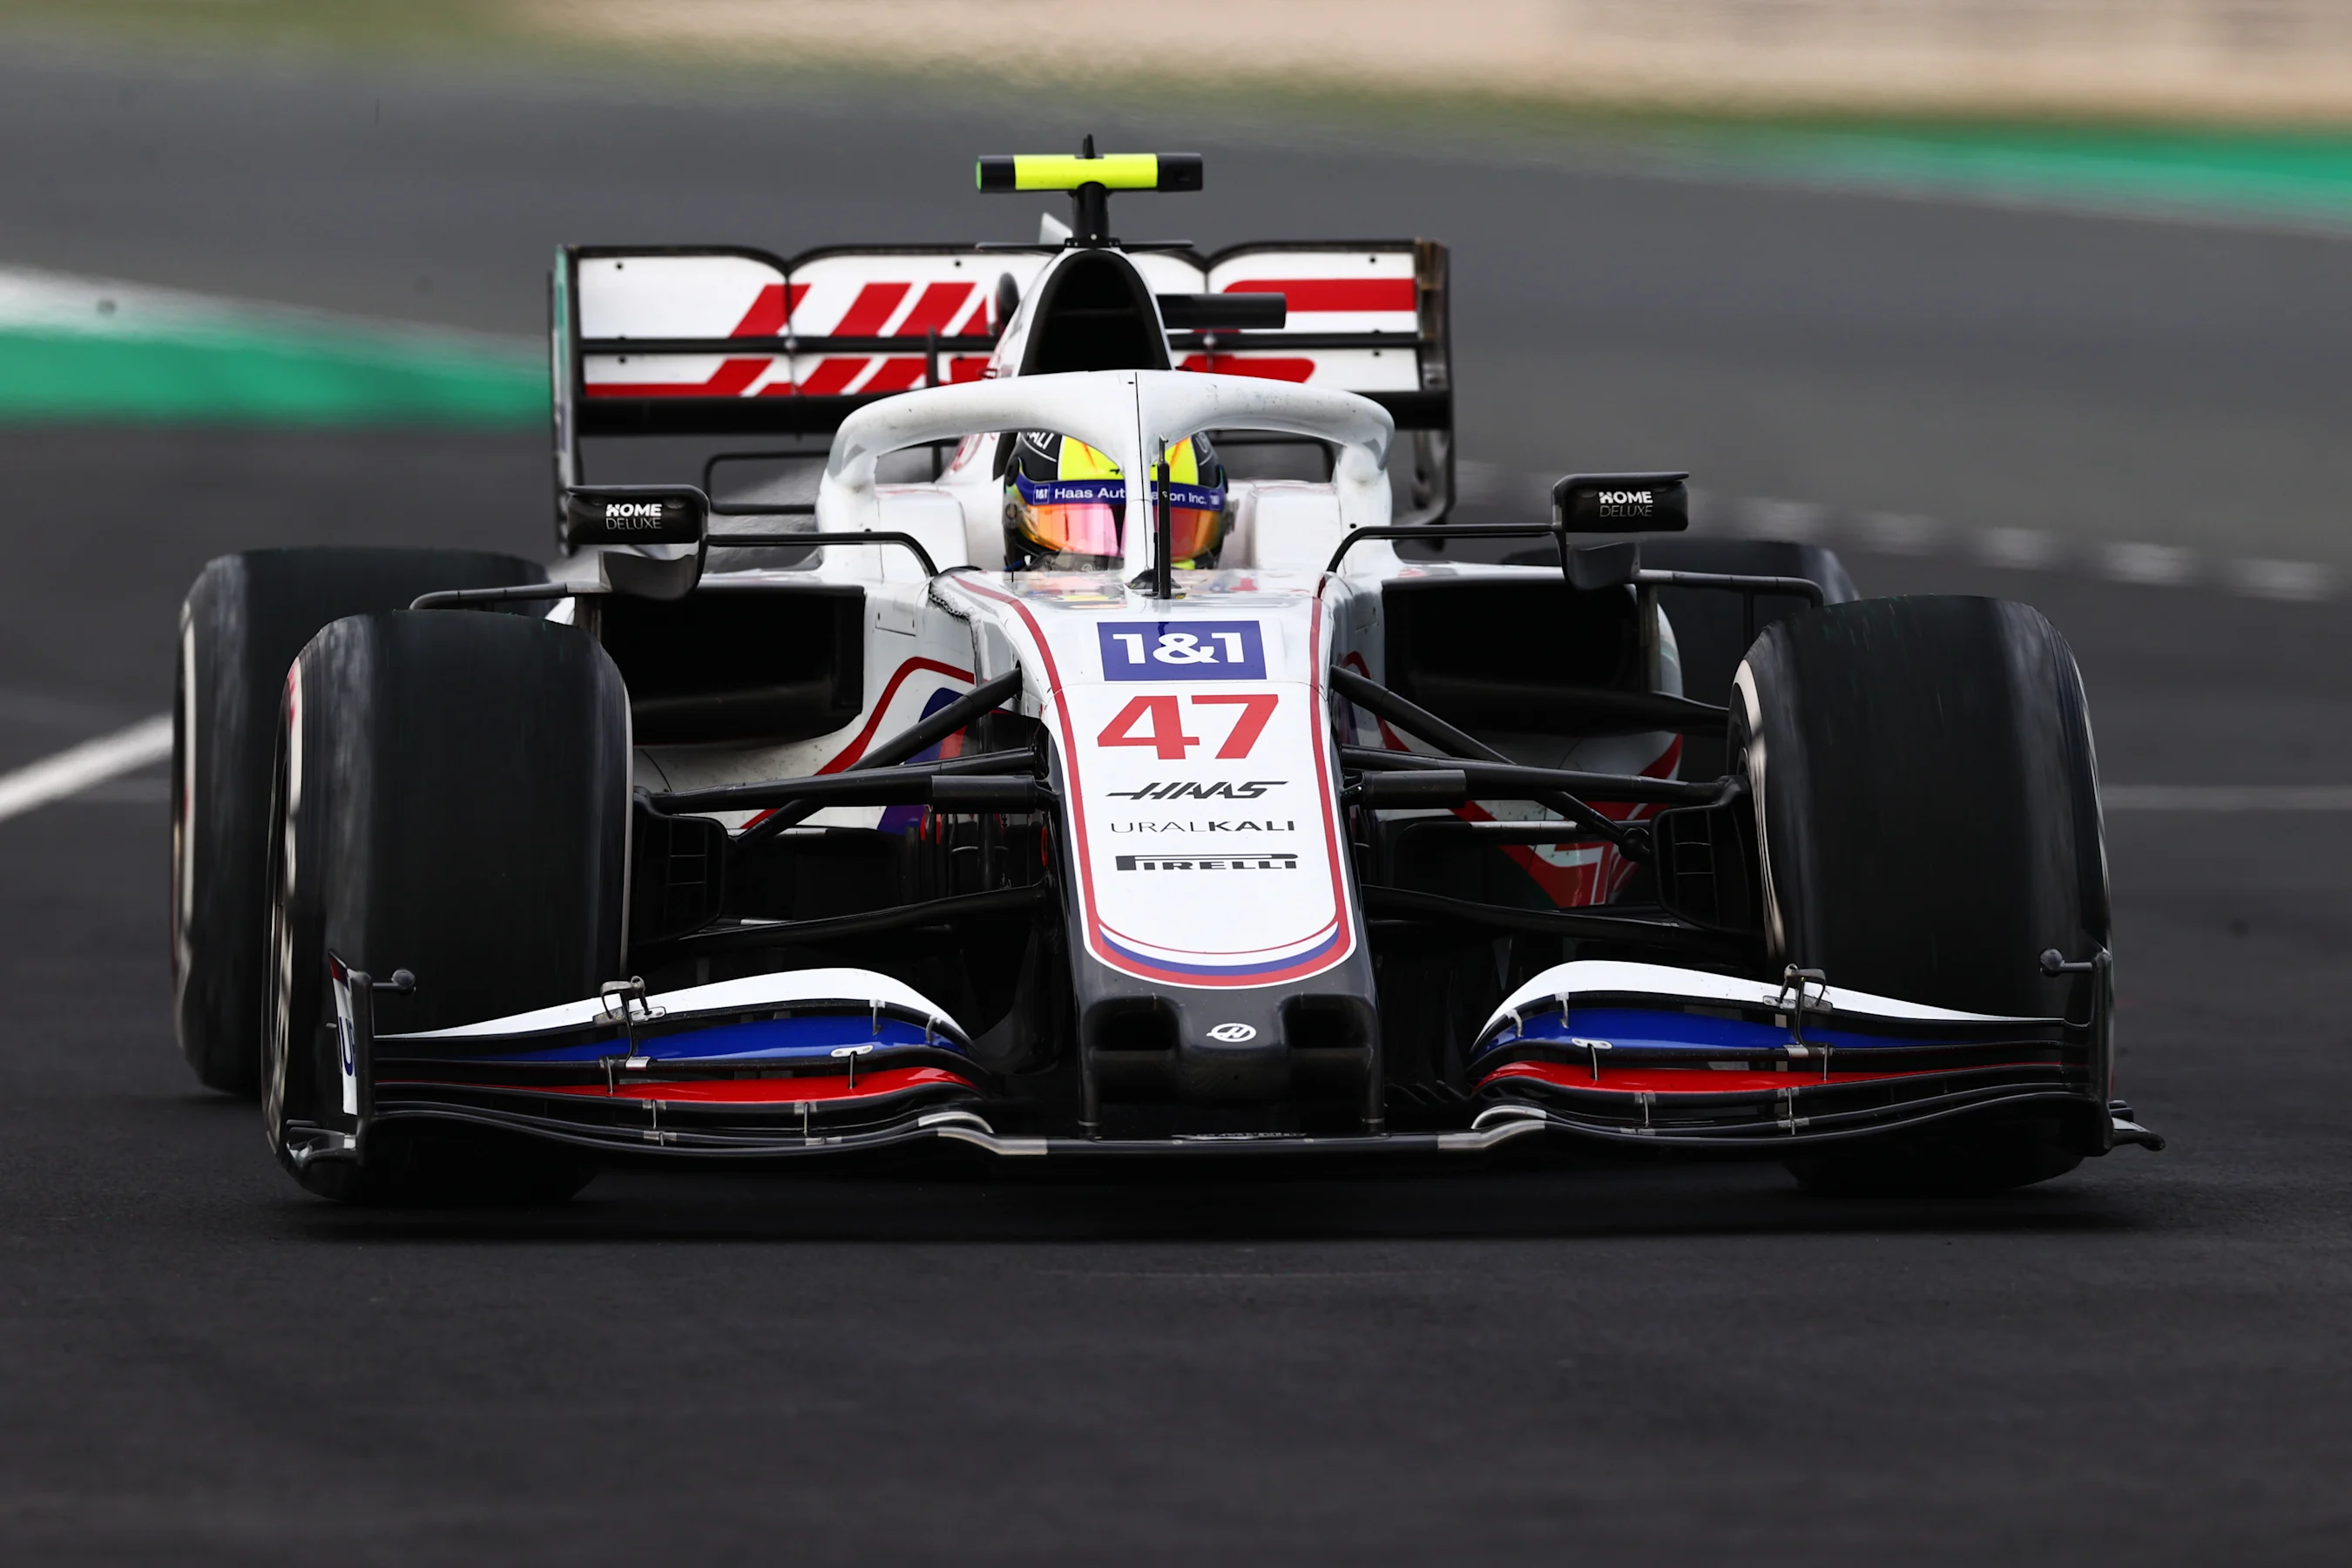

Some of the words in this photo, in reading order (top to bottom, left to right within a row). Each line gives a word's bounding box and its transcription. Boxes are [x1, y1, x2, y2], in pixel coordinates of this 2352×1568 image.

[1054, 488, 1093, 499] Haas
[1188, 492, 1206, 504] Inc.
[1598, 491, 1653, 504] HOME
[605, 504, 662, 517] HOME
[1599, 504, 1652, 517] DELUXE
[605, 517, 662, 530] DELUXE
[1112, 632, 1245, 665] 1&1
[1097, 694, 1279, 760] 47
[1105, 781, 1289, 801] HAAS
[1111, 821, 1295, 833] URALKALI
[1115, 854, 1298, 871] PIRELLI
